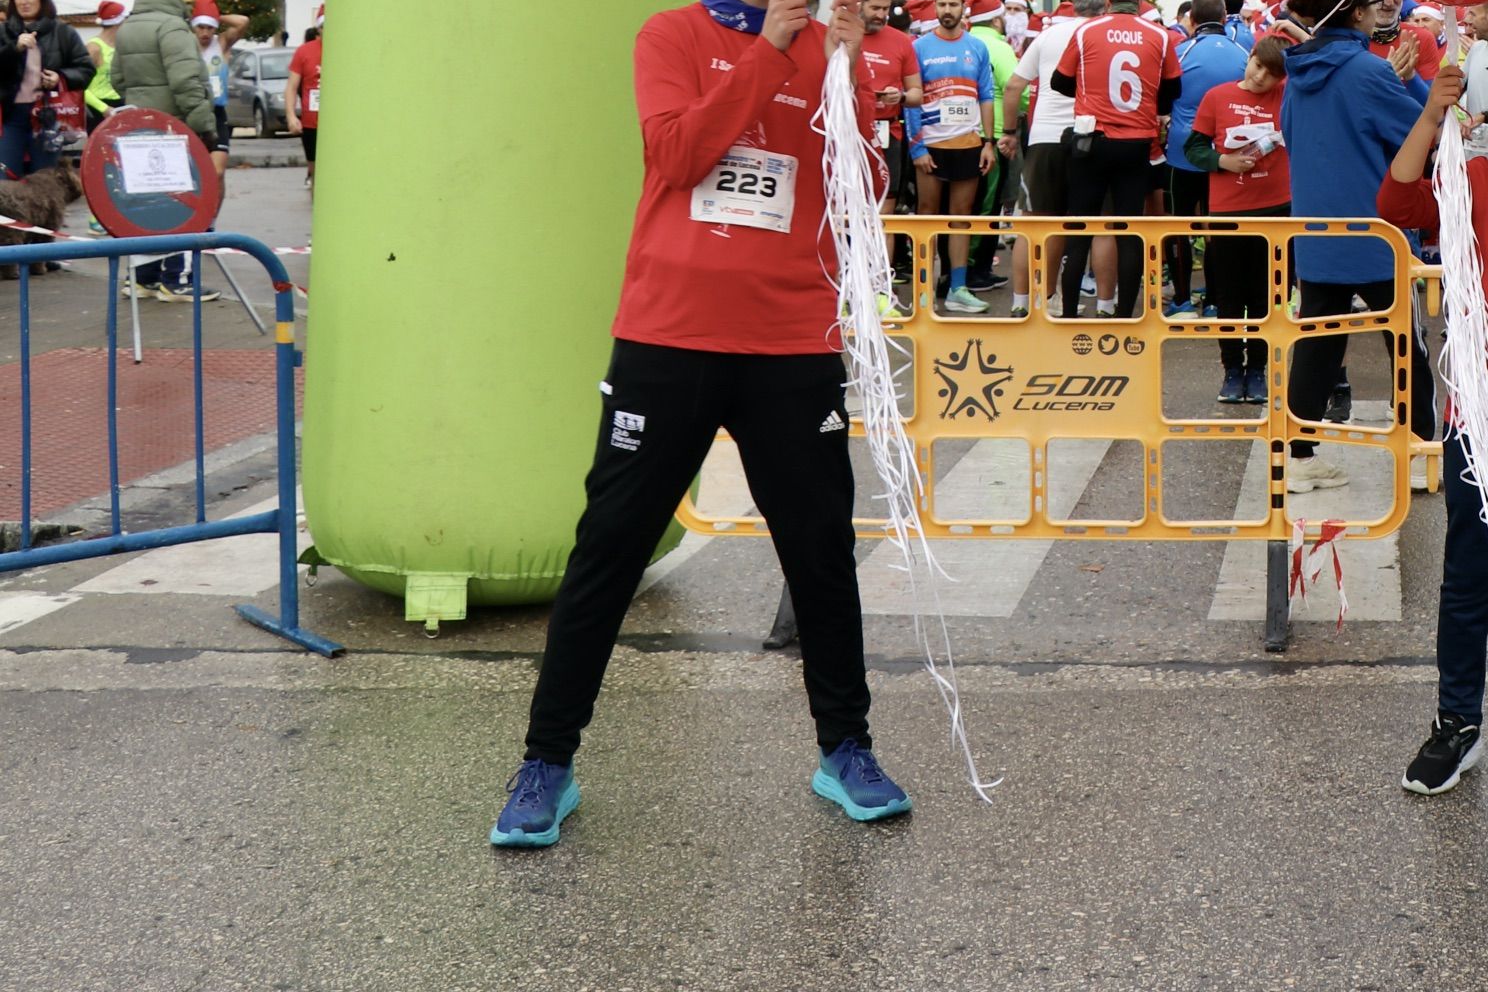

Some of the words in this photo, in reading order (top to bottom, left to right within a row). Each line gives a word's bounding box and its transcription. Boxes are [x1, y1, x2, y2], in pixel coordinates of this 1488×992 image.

[1106, 29, 1144, 45] COQUE
[1108, 50, 1143, 113] 6
[948, 107, 969, 115] 581
[716, 170, 777, 198] 223
[1012, 398, 1115, 412] Lucena
